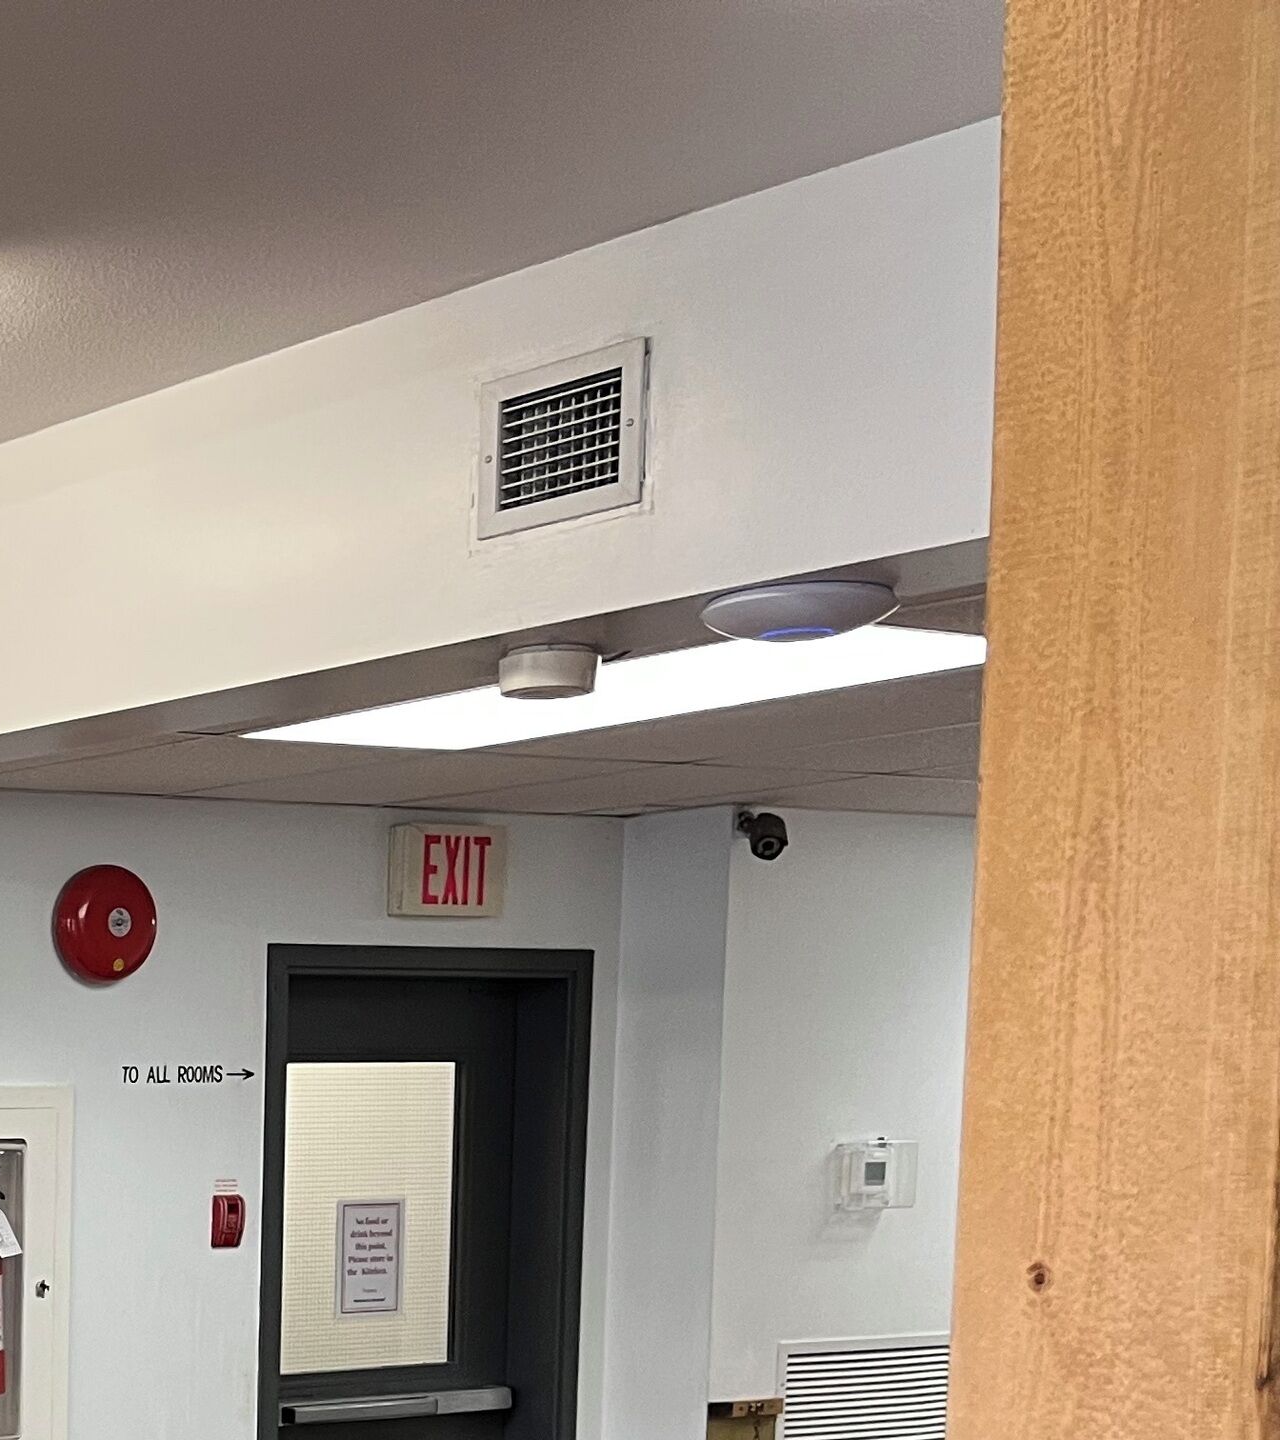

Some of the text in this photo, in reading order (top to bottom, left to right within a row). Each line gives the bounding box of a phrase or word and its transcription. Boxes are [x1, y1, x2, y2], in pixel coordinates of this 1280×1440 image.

[420, 834, 492, 906] EXIT
[122, 1064, 223, 1084] TO ALL ROOMS
